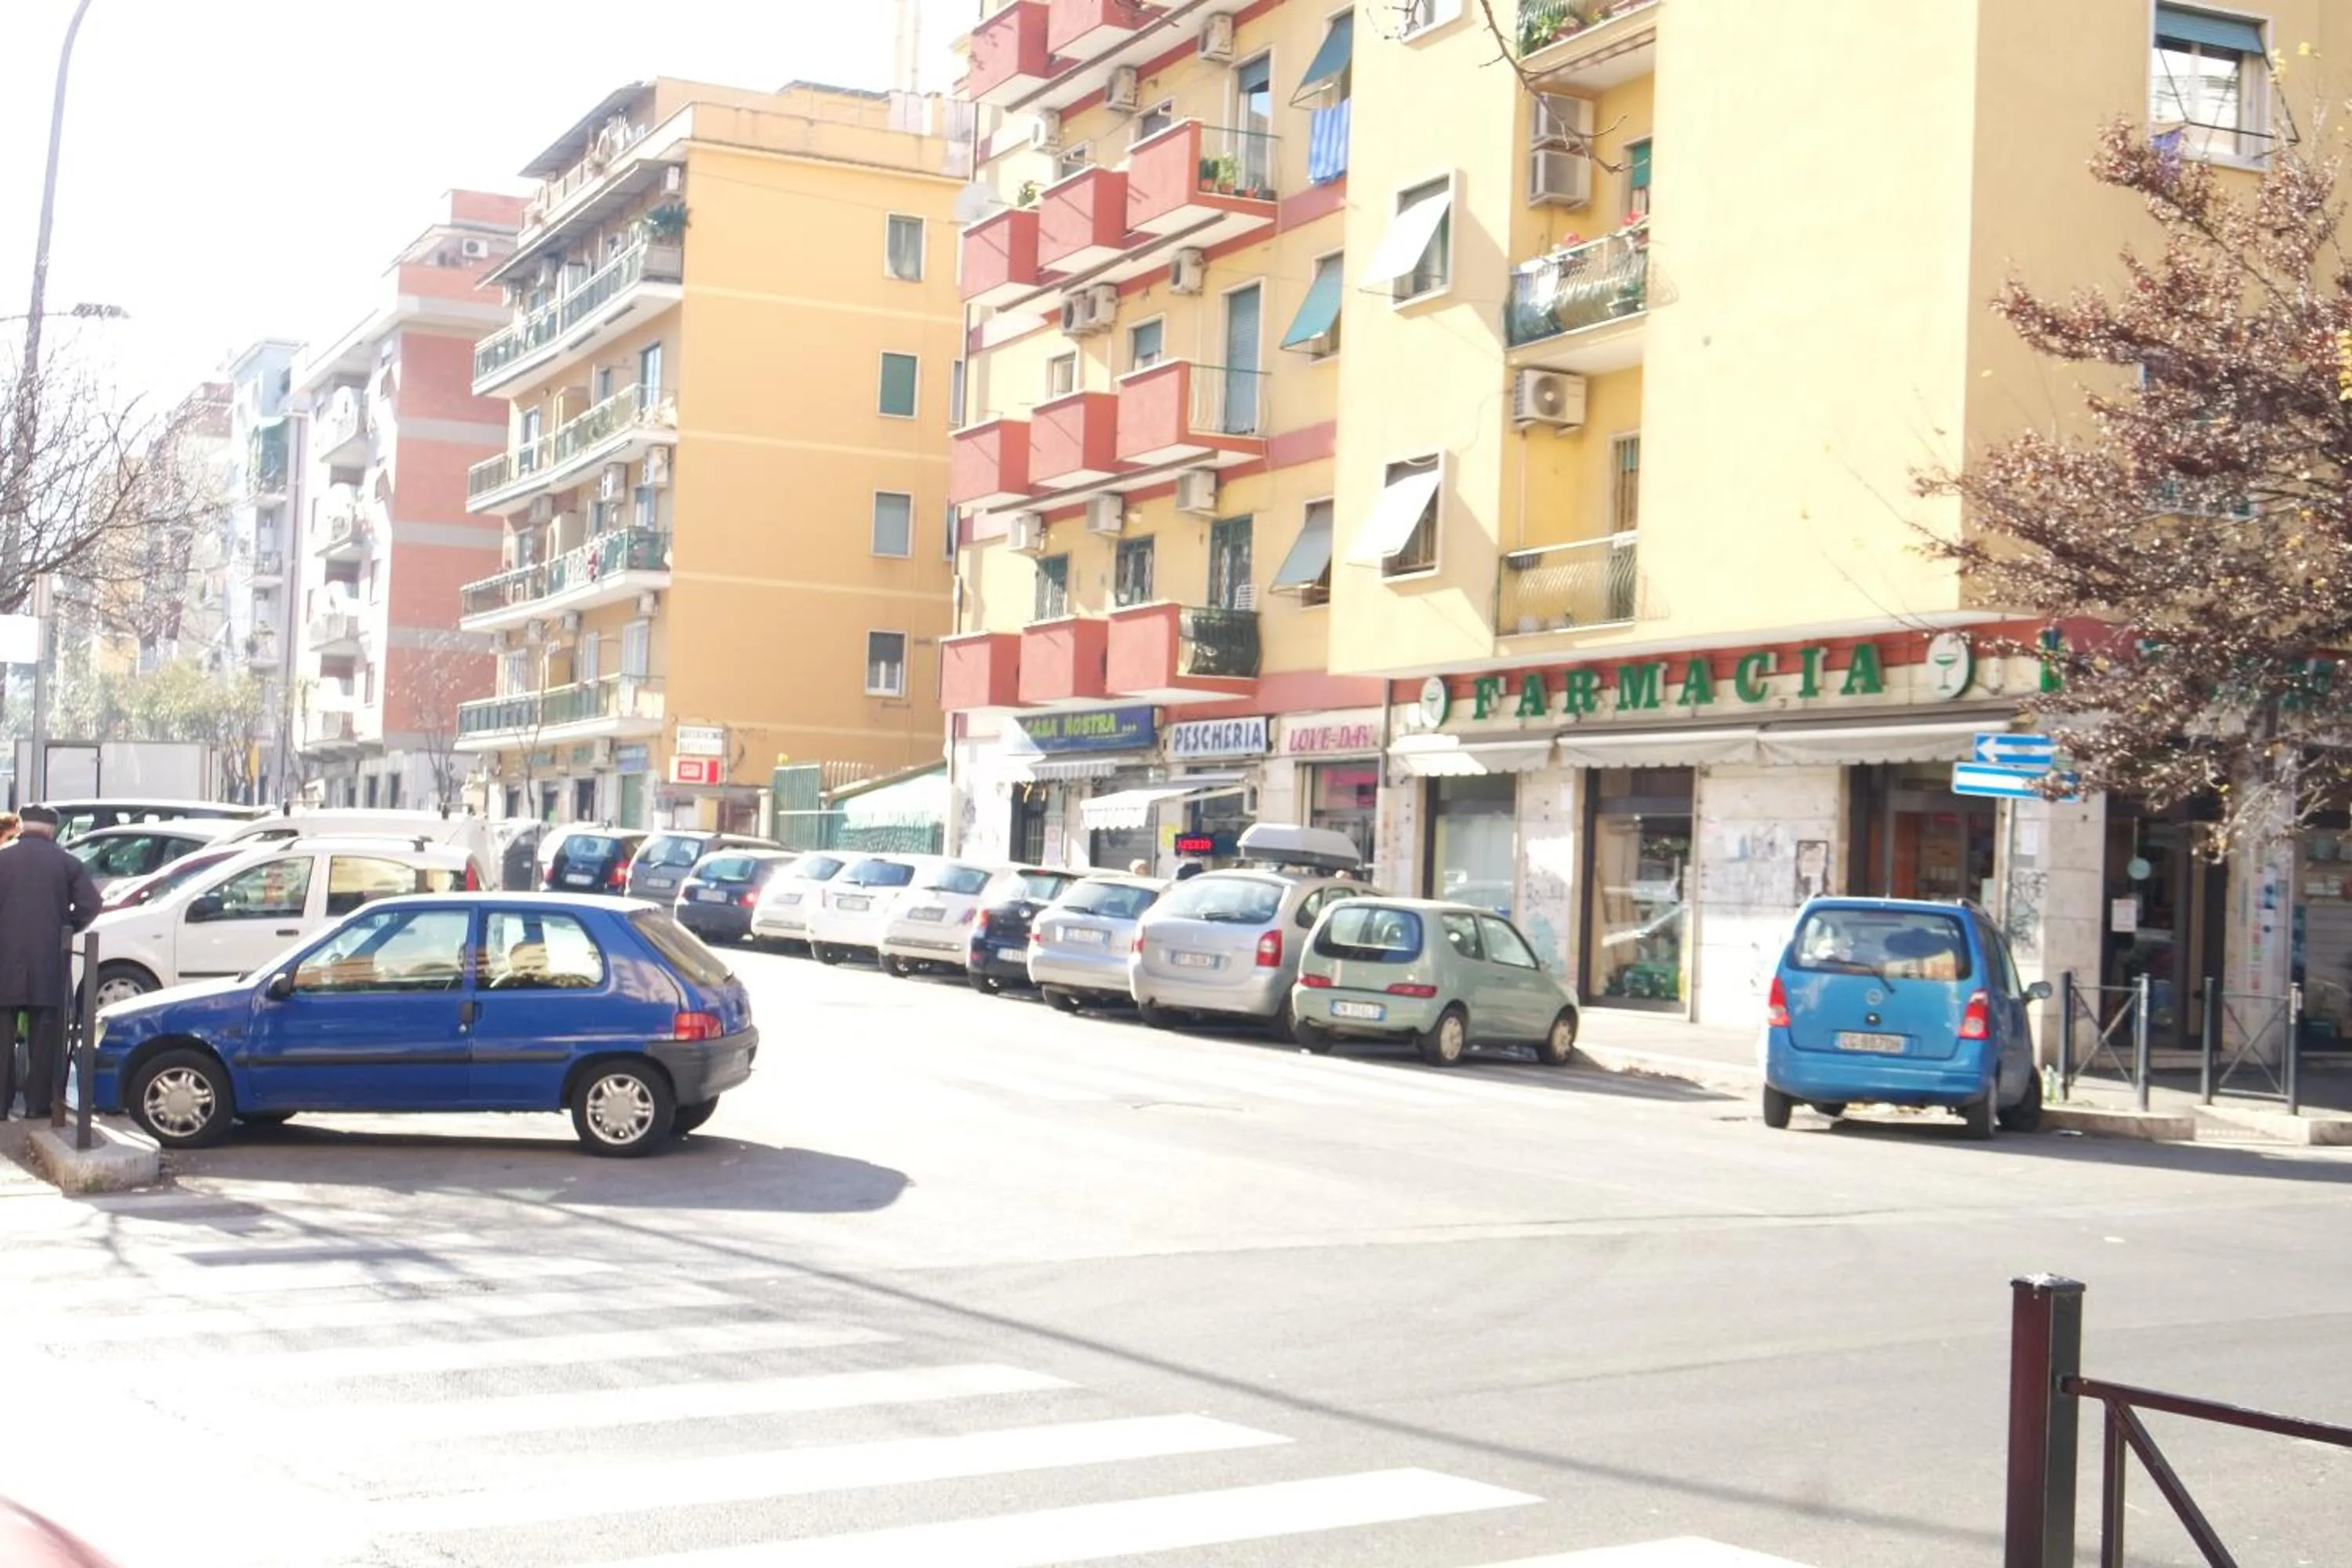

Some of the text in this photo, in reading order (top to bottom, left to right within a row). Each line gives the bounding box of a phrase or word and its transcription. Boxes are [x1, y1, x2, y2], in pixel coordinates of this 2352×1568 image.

[1472, 643, 1884, 720] FARMACIA
[1064, 713, 1116, 736] NOSTRA
[1174, 721, 1263, 751] PESCHERIA
